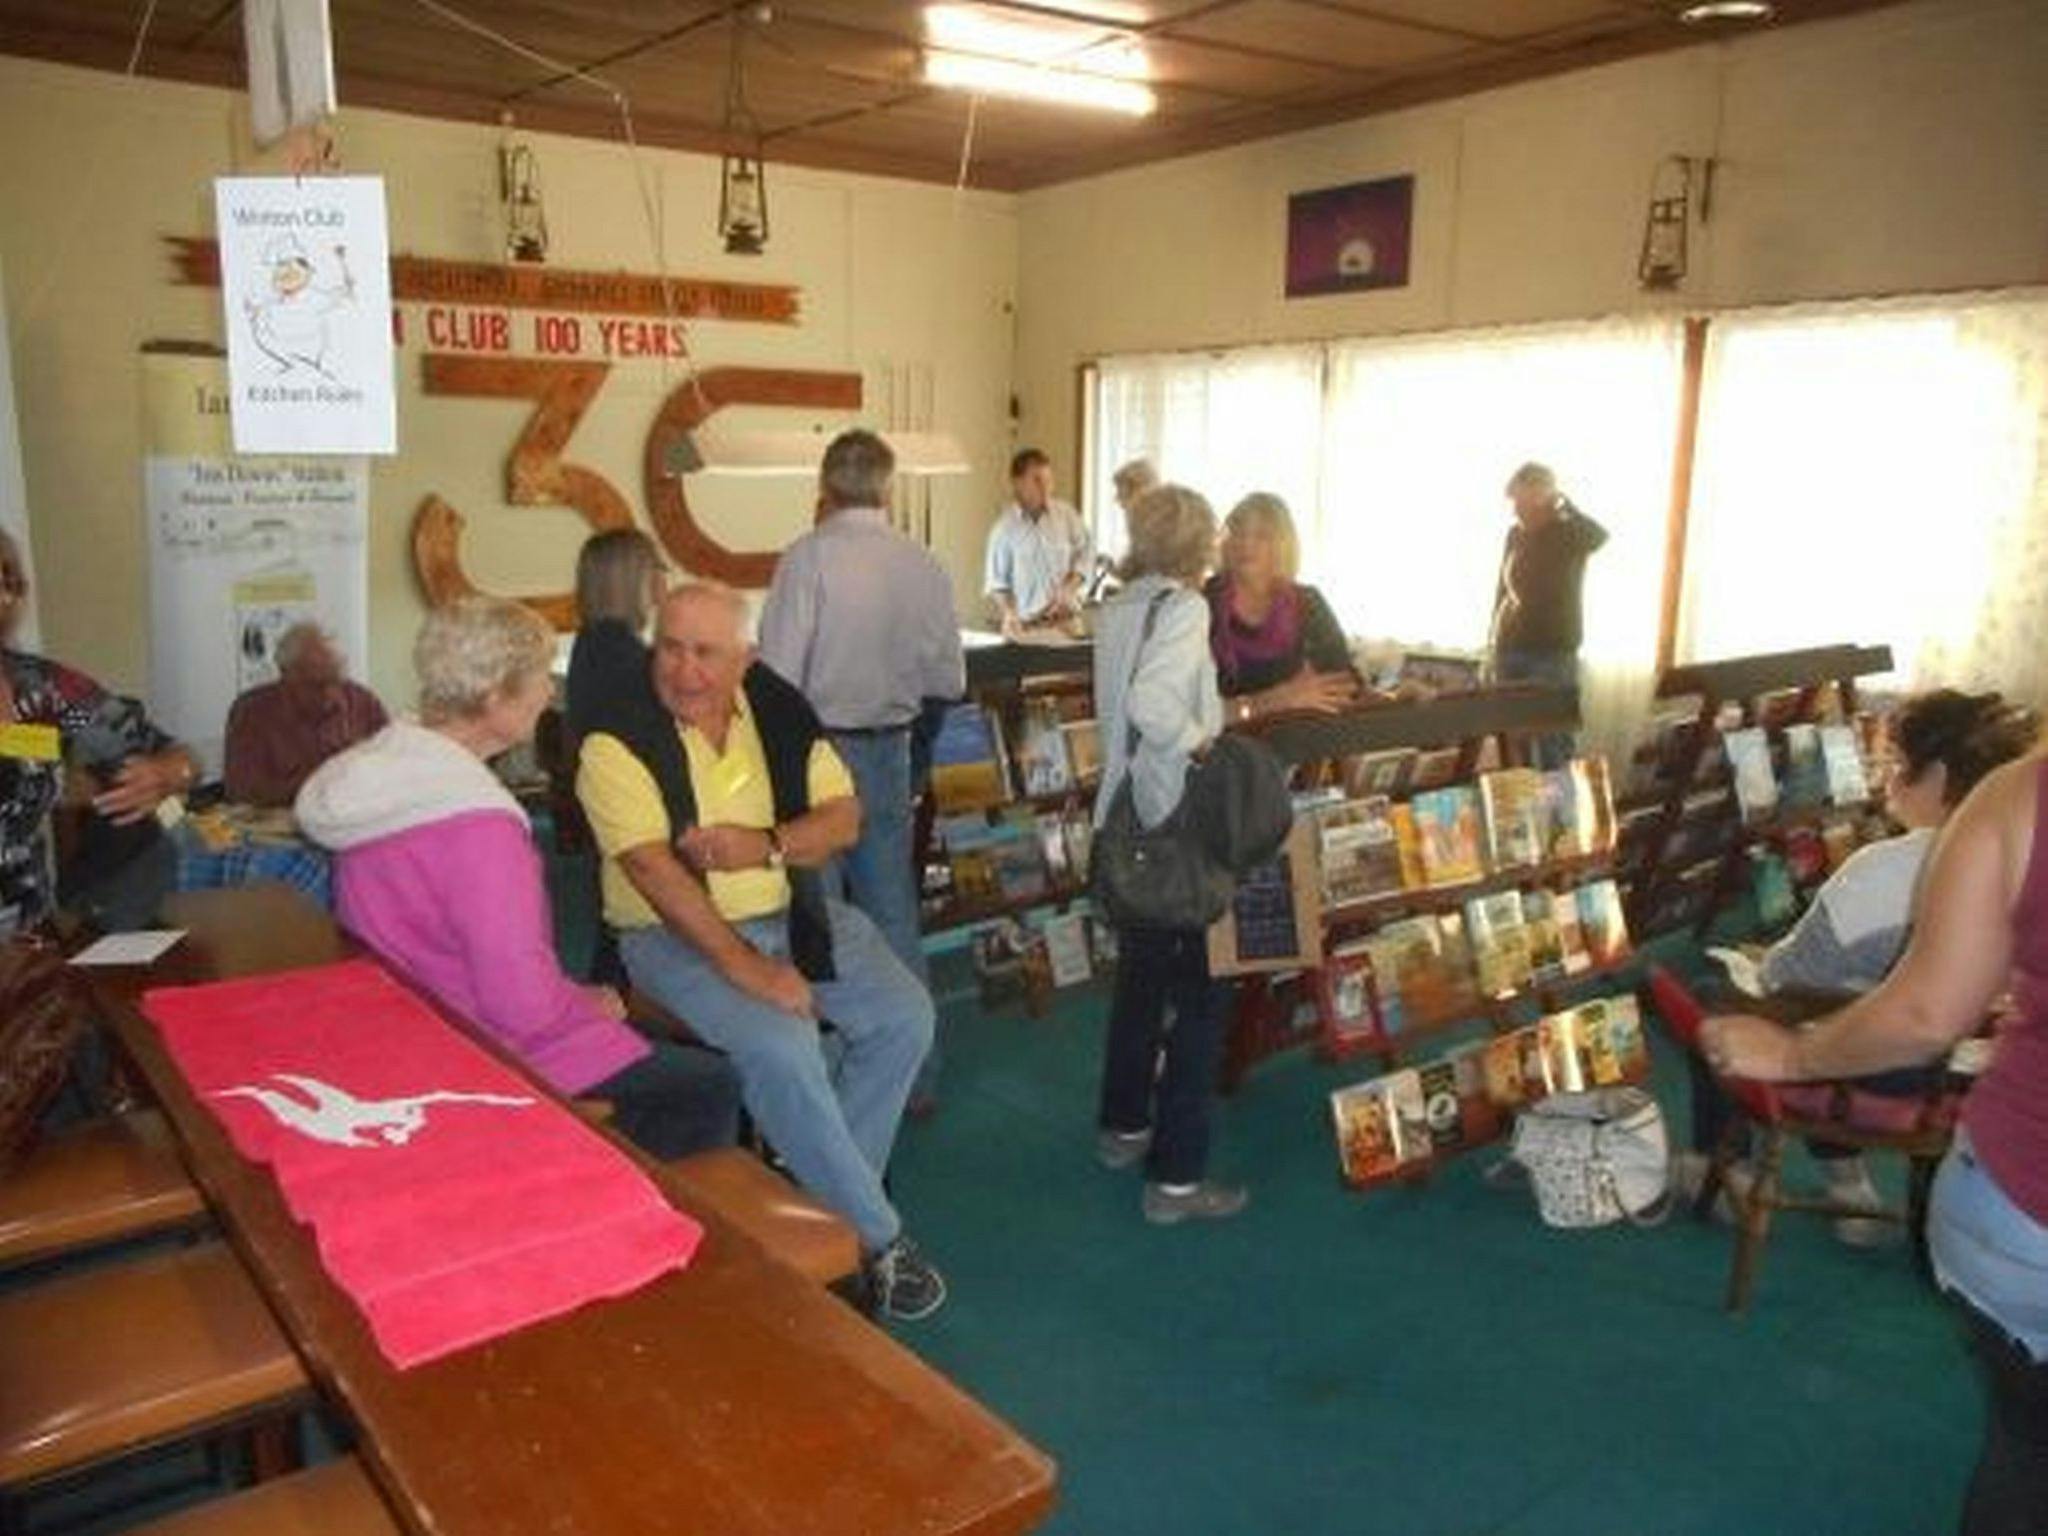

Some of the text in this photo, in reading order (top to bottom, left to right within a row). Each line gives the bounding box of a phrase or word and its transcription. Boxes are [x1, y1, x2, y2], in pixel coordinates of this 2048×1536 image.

[303, 206, 345, 226] Club
[427, 308, 509, 350] CLUB
[535, 316, 581, 355] 100
[598, 319, 690, 359] YEARS
[248, 386, 313, 402] Kitchen
